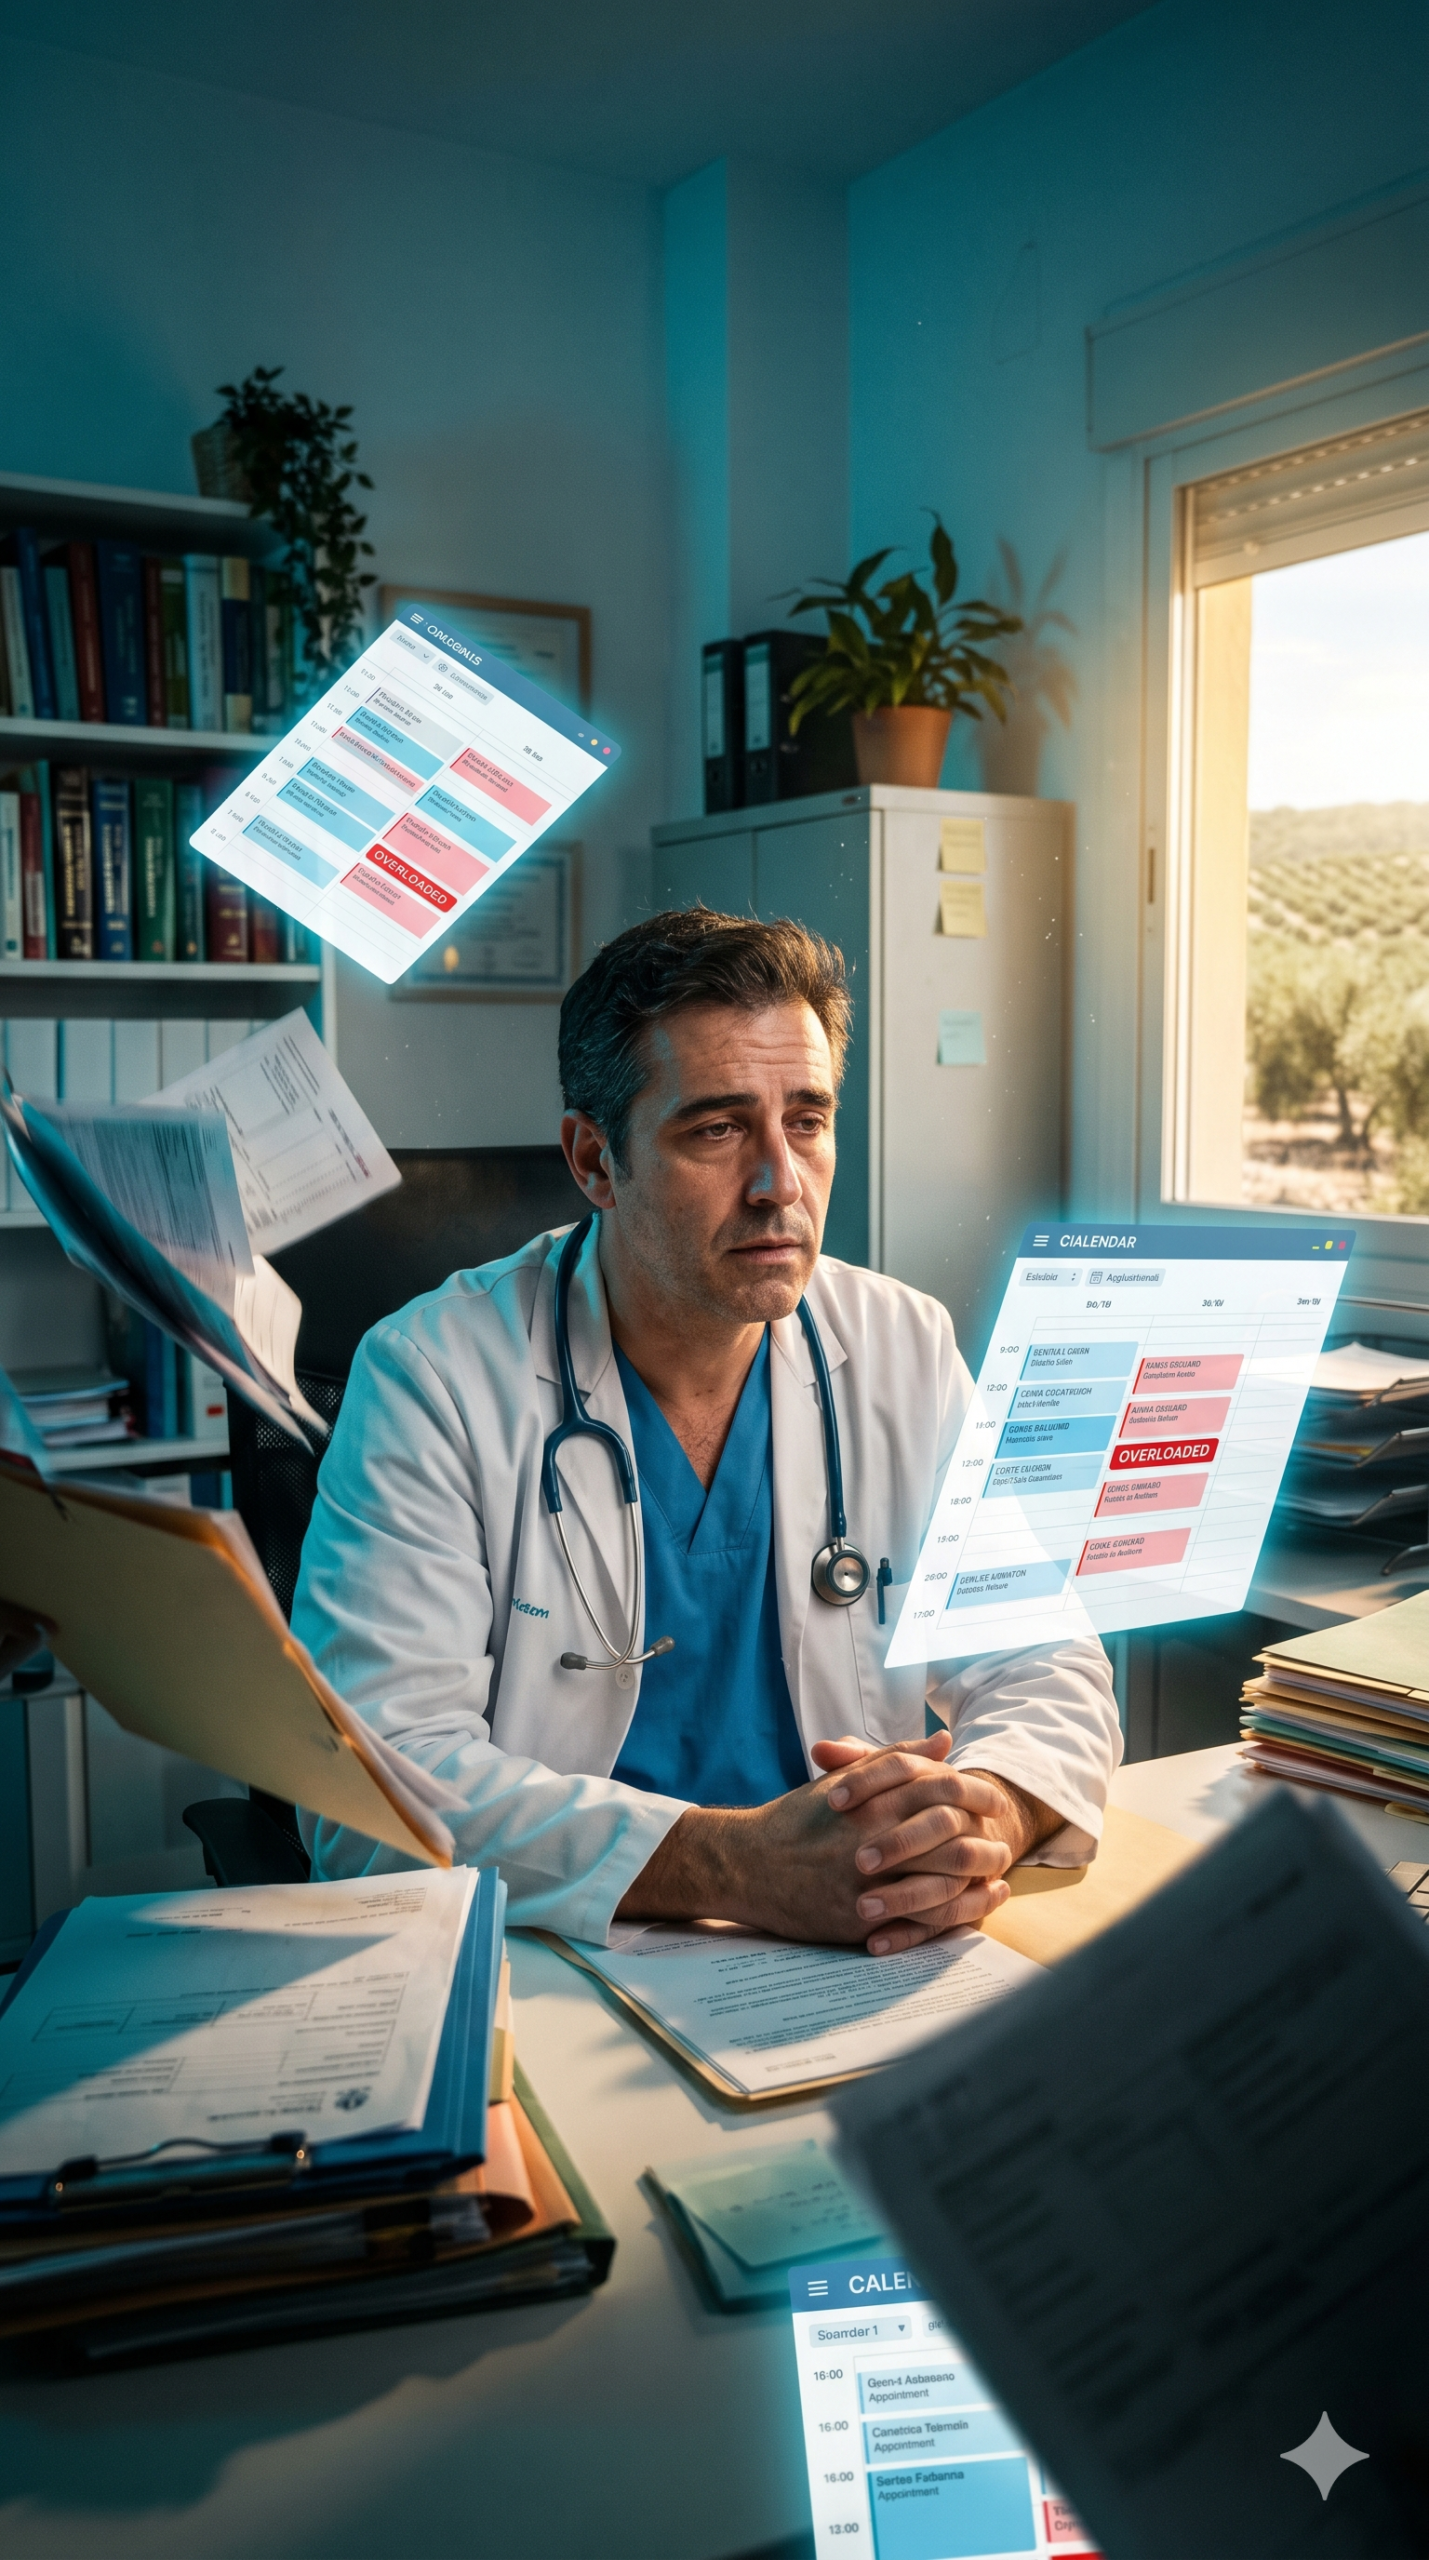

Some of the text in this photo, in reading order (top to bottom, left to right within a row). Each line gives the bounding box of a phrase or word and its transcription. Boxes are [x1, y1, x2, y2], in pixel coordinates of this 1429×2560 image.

[373, 849, 448, 906] OVERLOADED
[1000, 1345, 1020, 1354] 9:00
[986, 1383, 1008, 1392] 12:00
[1118, 1443, 1210, 1463] OVERLOADED
[962, 1459, 984, 1467] 12:00
[950, 1497, 972, 1505] 18:00
[913, 1609, 935, 1619] 17:00
[873, 2325, 878, 2336] 1
[813, 2368, 843, 2381] 16:00
